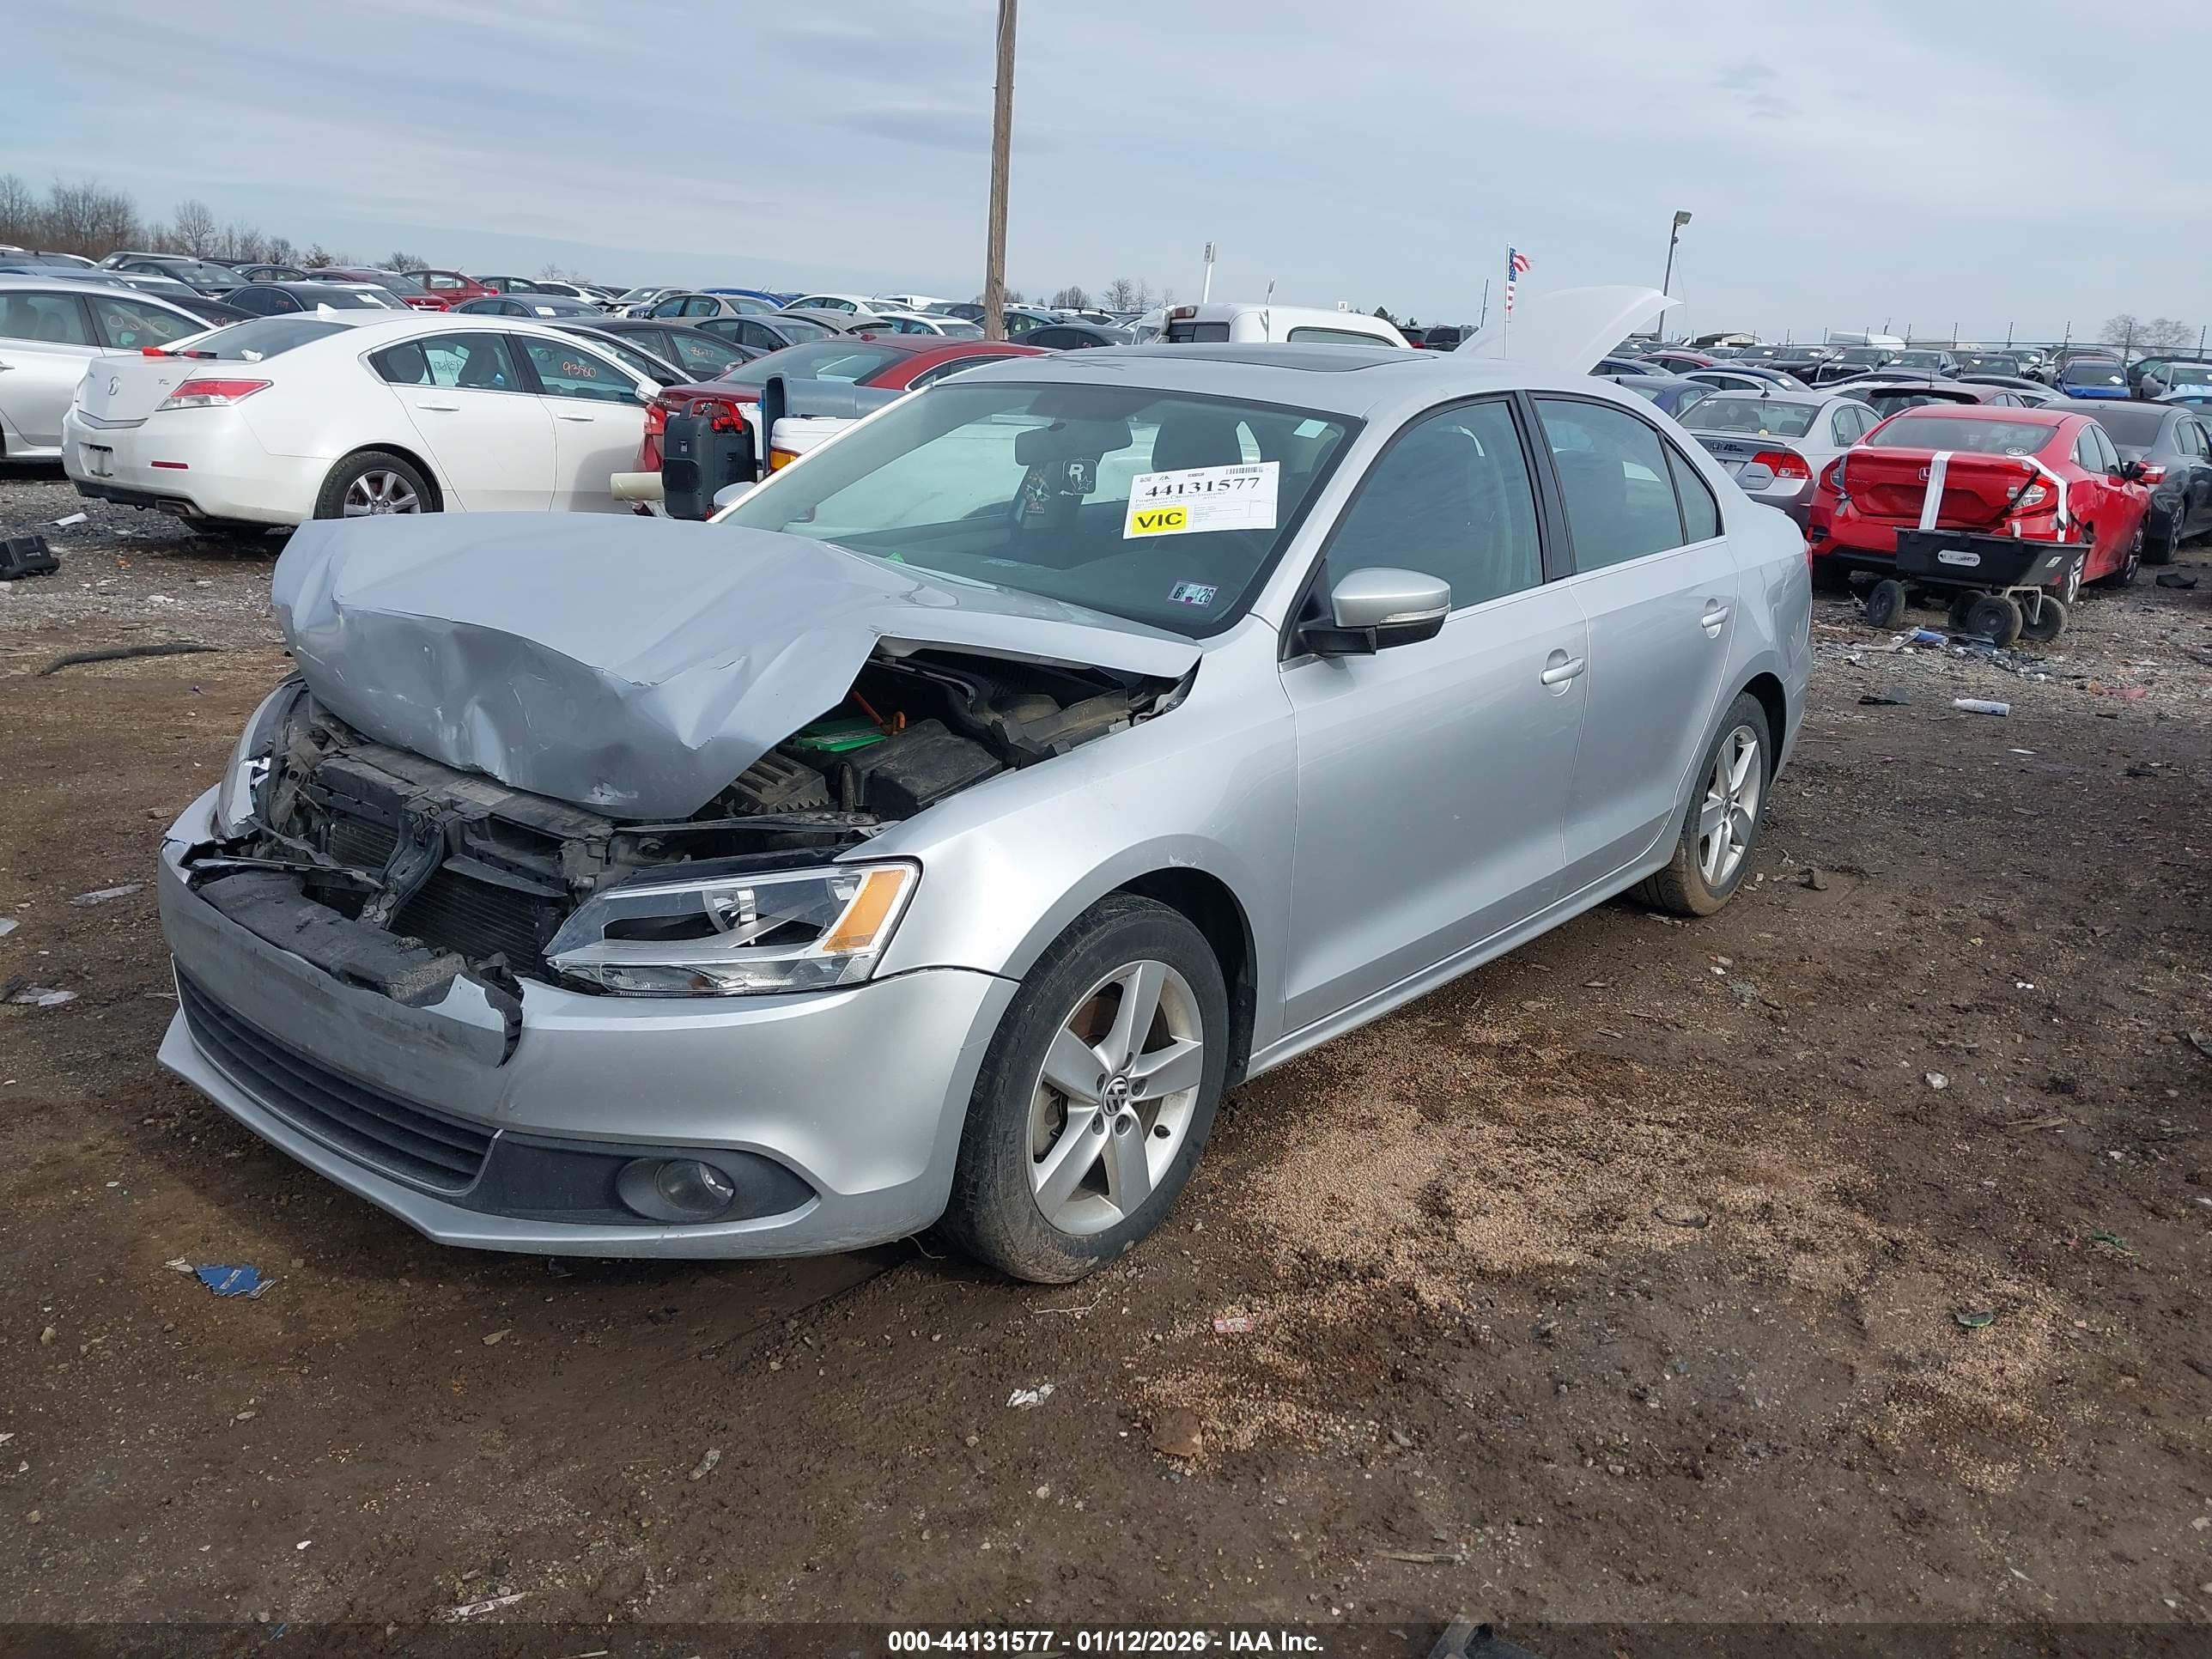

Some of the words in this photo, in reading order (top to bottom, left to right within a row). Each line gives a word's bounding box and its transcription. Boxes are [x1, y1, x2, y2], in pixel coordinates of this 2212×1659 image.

[562, 361, 597, 378] 9380
[1145, 477, 1261, 497] 44131577
[1137, 512, 1183, 529] VIC
[1198, 587, 1214, 604] 26
